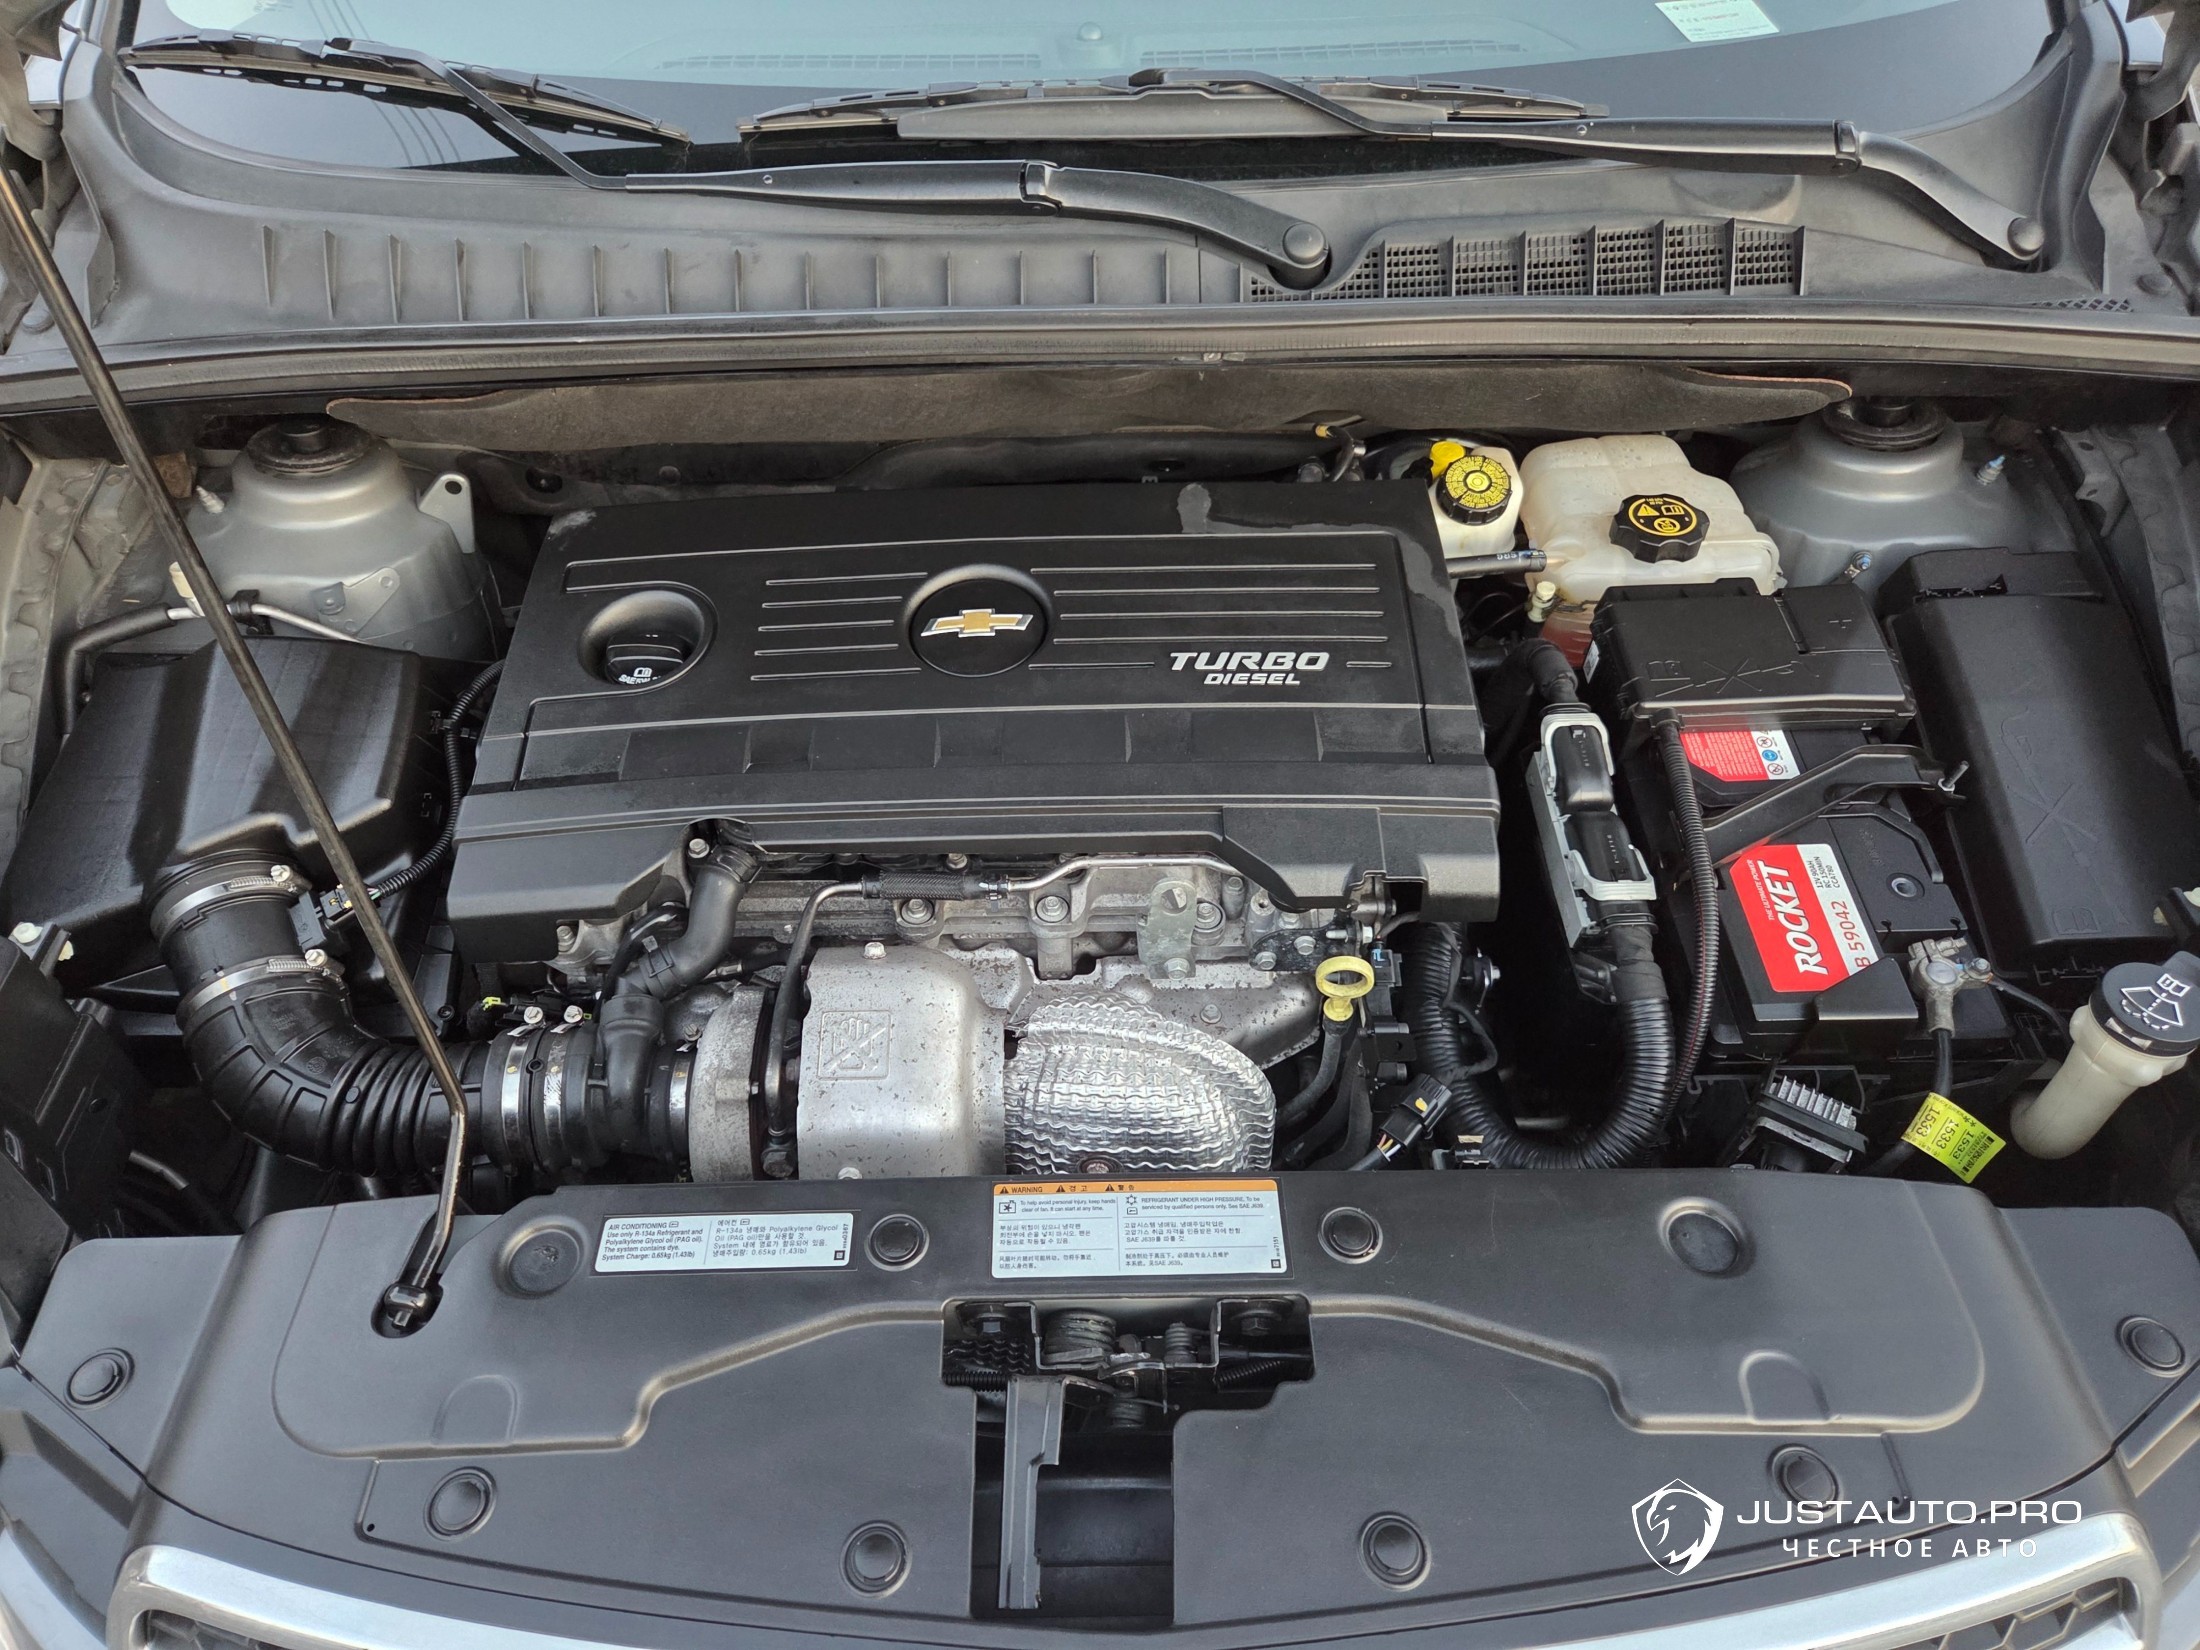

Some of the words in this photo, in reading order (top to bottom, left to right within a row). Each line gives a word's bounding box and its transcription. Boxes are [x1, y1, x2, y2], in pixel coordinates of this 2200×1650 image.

[1170, 652, 1330, 671] TURBO
[619, 674, 636, 684] SAE
[1204, 673, 1300, 685] DIESEL
[1747, 859, 1761, 881] POWER
[1807, 861, 1819, 877] 90AH
[1814, 857, 1828, 879] 150MIN
[1813, 877, 1824, 889] 12V
[1826, 865, 1840, 889] CCA780
[1823, 880, 1832, 889] RC
[1754, 882, 1771, 908] ULTIMATE
[1757, 860, 1829, 975] ROCKET
[1765, 908, 1775, 921] THE
[1830, 901, 1865, 952] 59042
[1916, 1106, 1941, 1137] 1533
[1936, 1119, 1960, 1150] 1533
[1953, 1131, 1975, 1160] 1533
[621, 1222, 667, 1230] CONDITIONING
[718, 1219, 737, 1227] 에어컨
[747, 1226, 766, 1234] 냉매와
[770, 1225, 813, 1233] Polyalkylene
[816, 1224, 838, 1232] Glycol
[620, 1231, 634, 1239] only
[657, 1229, 690, 1238] Refrigerant
[675, 1236, 690, 1244] (PAG
[747, 1233, 771, 1241] oil)만을
[798, 1232, 806, 1240] 것.
[617, 1246, 639, 1254] system
[667, 1245, 679, 1253] dye.
[742, 1241, 756, 1249] 내에
[812, 1239, 828, 1247] 있음.
[626, 1253, 650, 1261] Charge:
[651, 1252, 672, 1260] 0.65kg
[672, 1251, 695, 1259] (1.43lb)
[713, 1249, 748, 1258] 냉매주입량:
